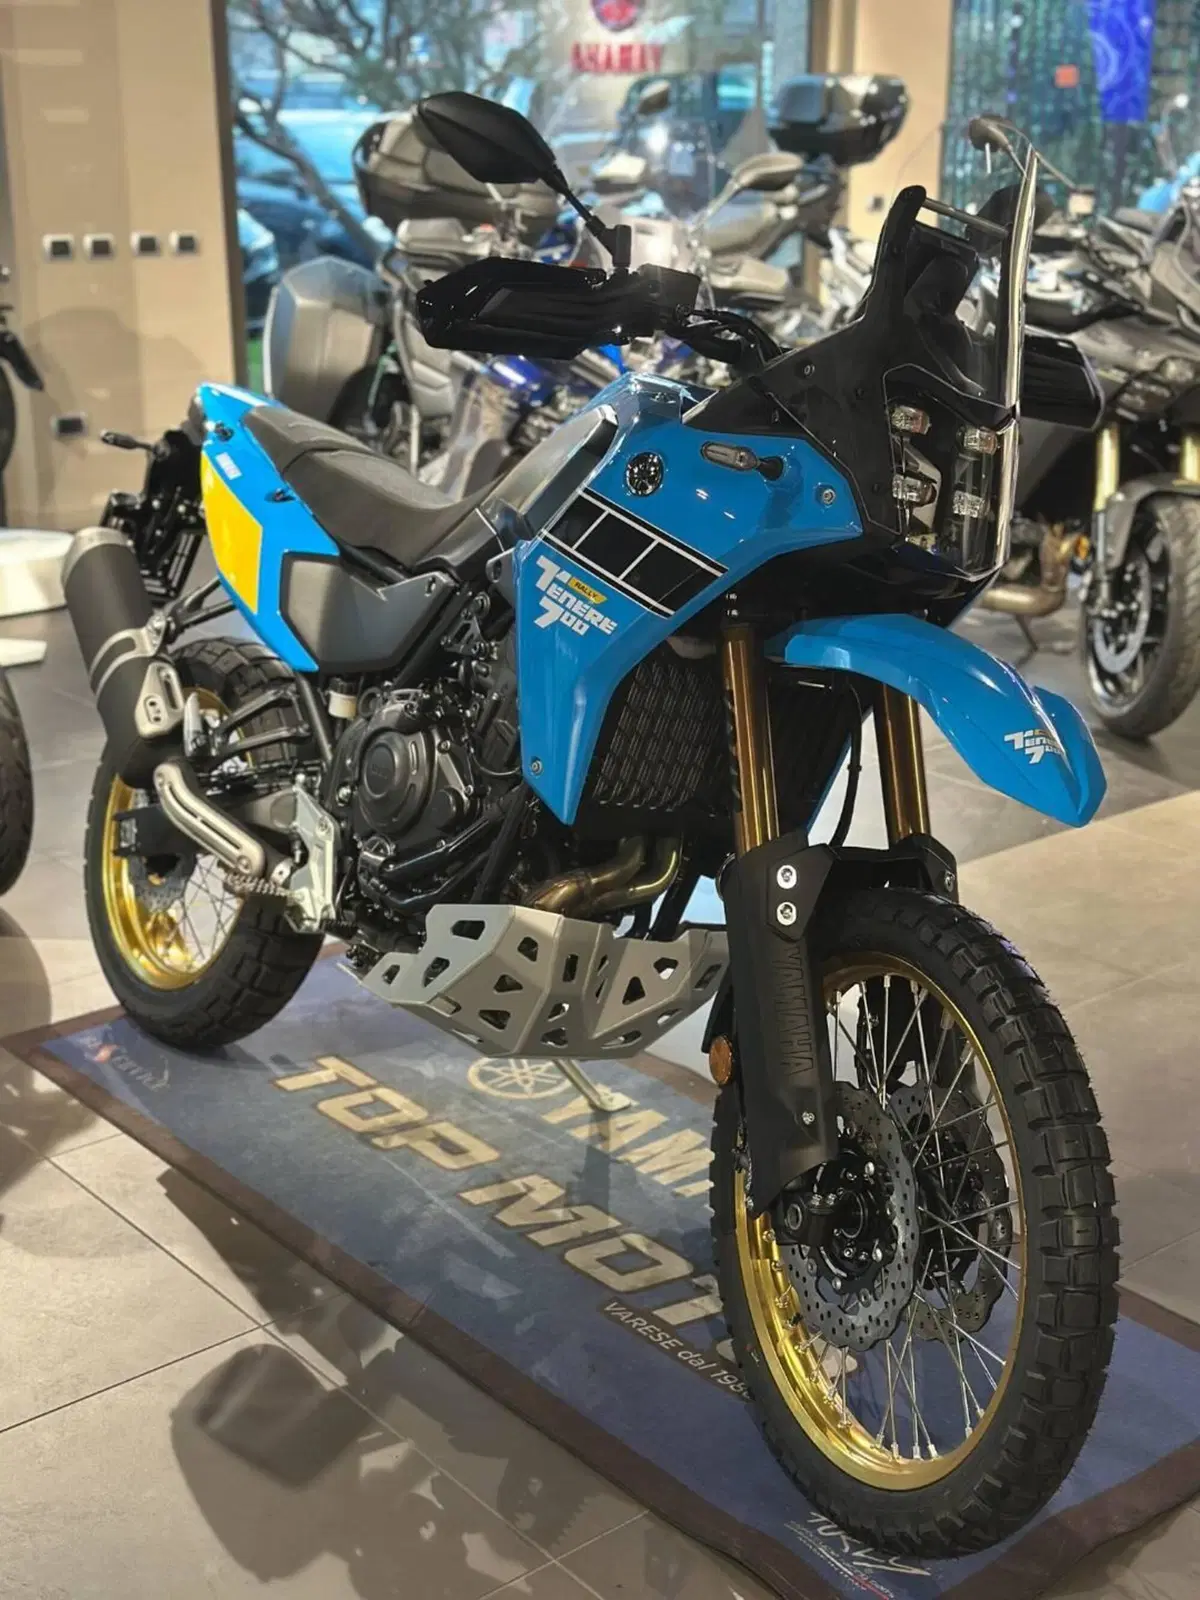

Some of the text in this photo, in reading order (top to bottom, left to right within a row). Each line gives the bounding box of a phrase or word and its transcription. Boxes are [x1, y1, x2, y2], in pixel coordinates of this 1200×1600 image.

[533, 595, 590, 636] 700
[573, 581, 599, 599] RALLY
[771, 943, 815, 1077] YAMAHA
[272, 1055, 501, 1172] TOP
[540, 1082, 715, 1198] YAM
[603, 1300, 684, 1351] VARESE
[676, 1350, 711, 1372] dal
